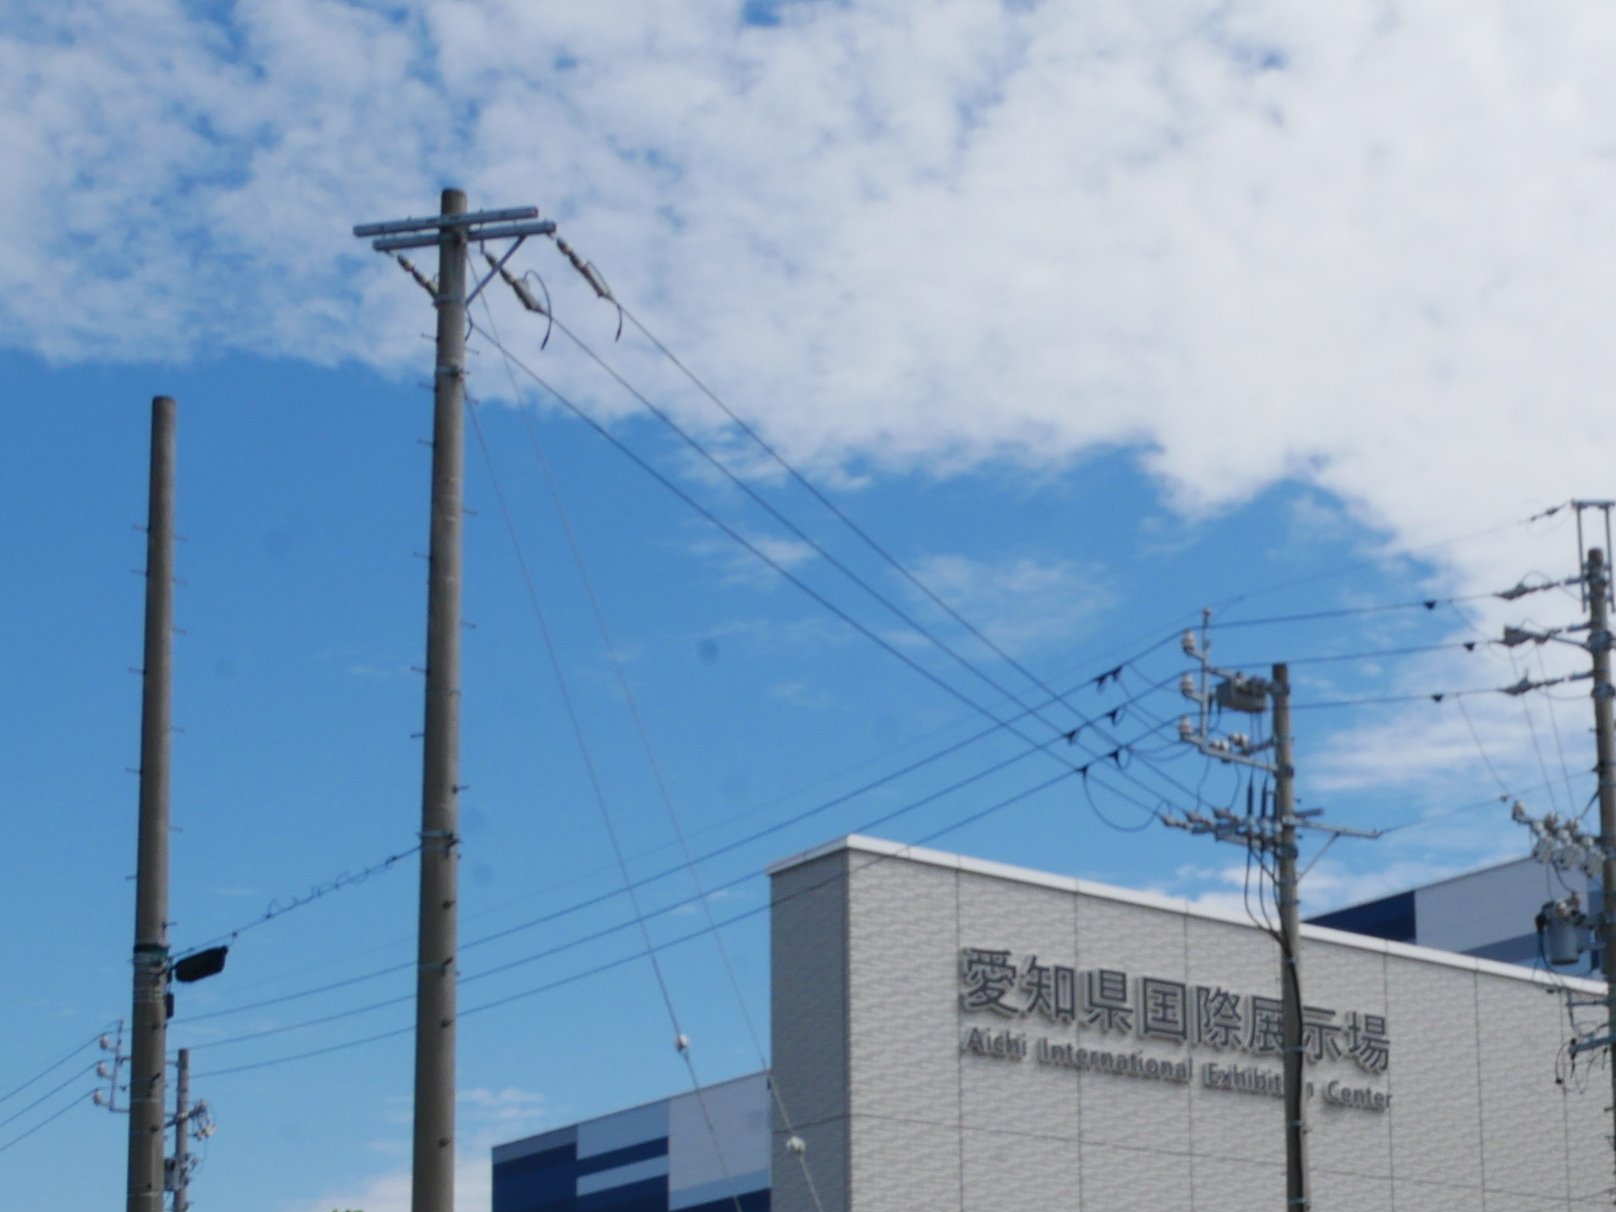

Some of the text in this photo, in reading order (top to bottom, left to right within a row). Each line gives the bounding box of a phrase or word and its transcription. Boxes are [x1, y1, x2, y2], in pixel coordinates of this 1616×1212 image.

[964, 947, 1391, 1071] 愛知県国際展示場
[965, 1026, 1028, 1059] Aichi
[1039, 1036, 1193, 1084] International
[1326, 1079, 1393, 1109] Center
